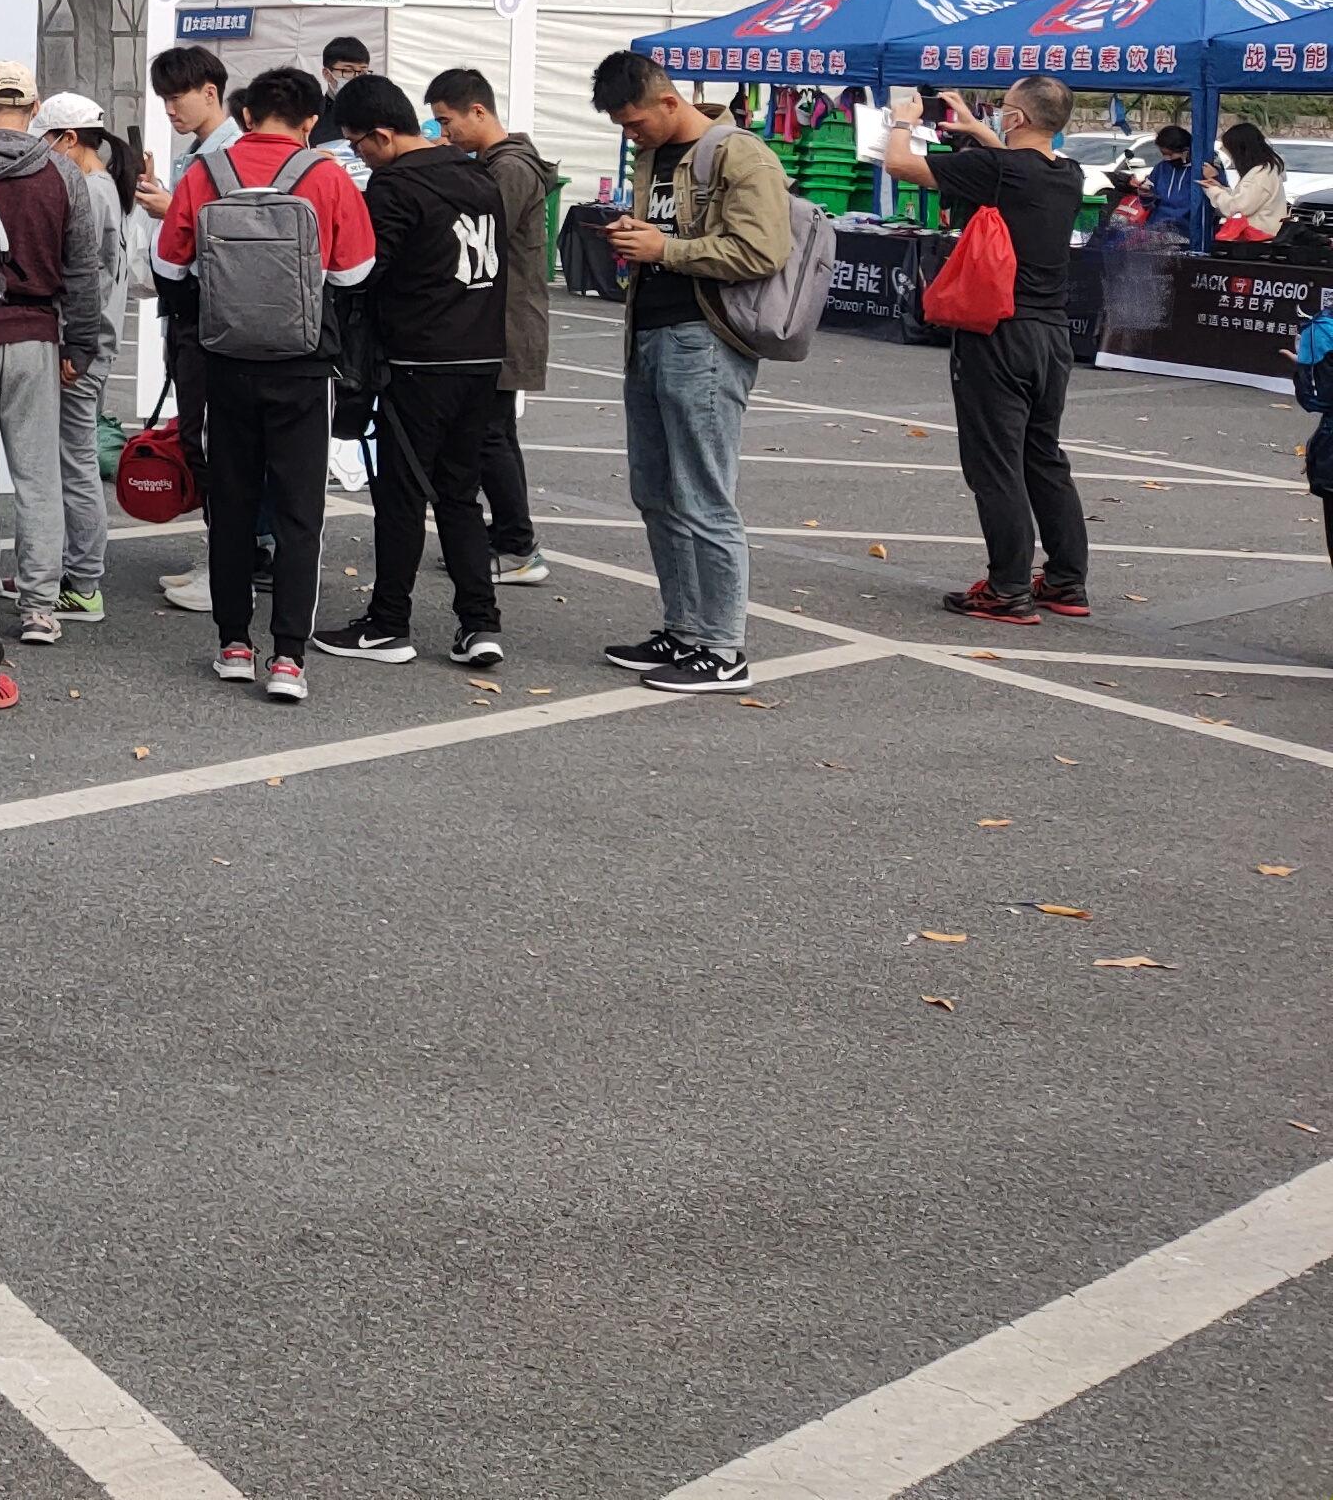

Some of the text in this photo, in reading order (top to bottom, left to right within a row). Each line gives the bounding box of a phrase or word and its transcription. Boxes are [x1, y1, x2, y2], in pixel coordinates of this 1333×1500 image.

[920, 44, 1178, 74] 战马能量型维生素饮料
[1242, 42, 1329, 73] 战马能
[829, 259, 882, 294] 跑能
[1192, 272, 1309, 300] JACK BAGGIO
[867, 301, 890, 316] Run
[1218, 294, 1275, 313] 杰克巴乔
